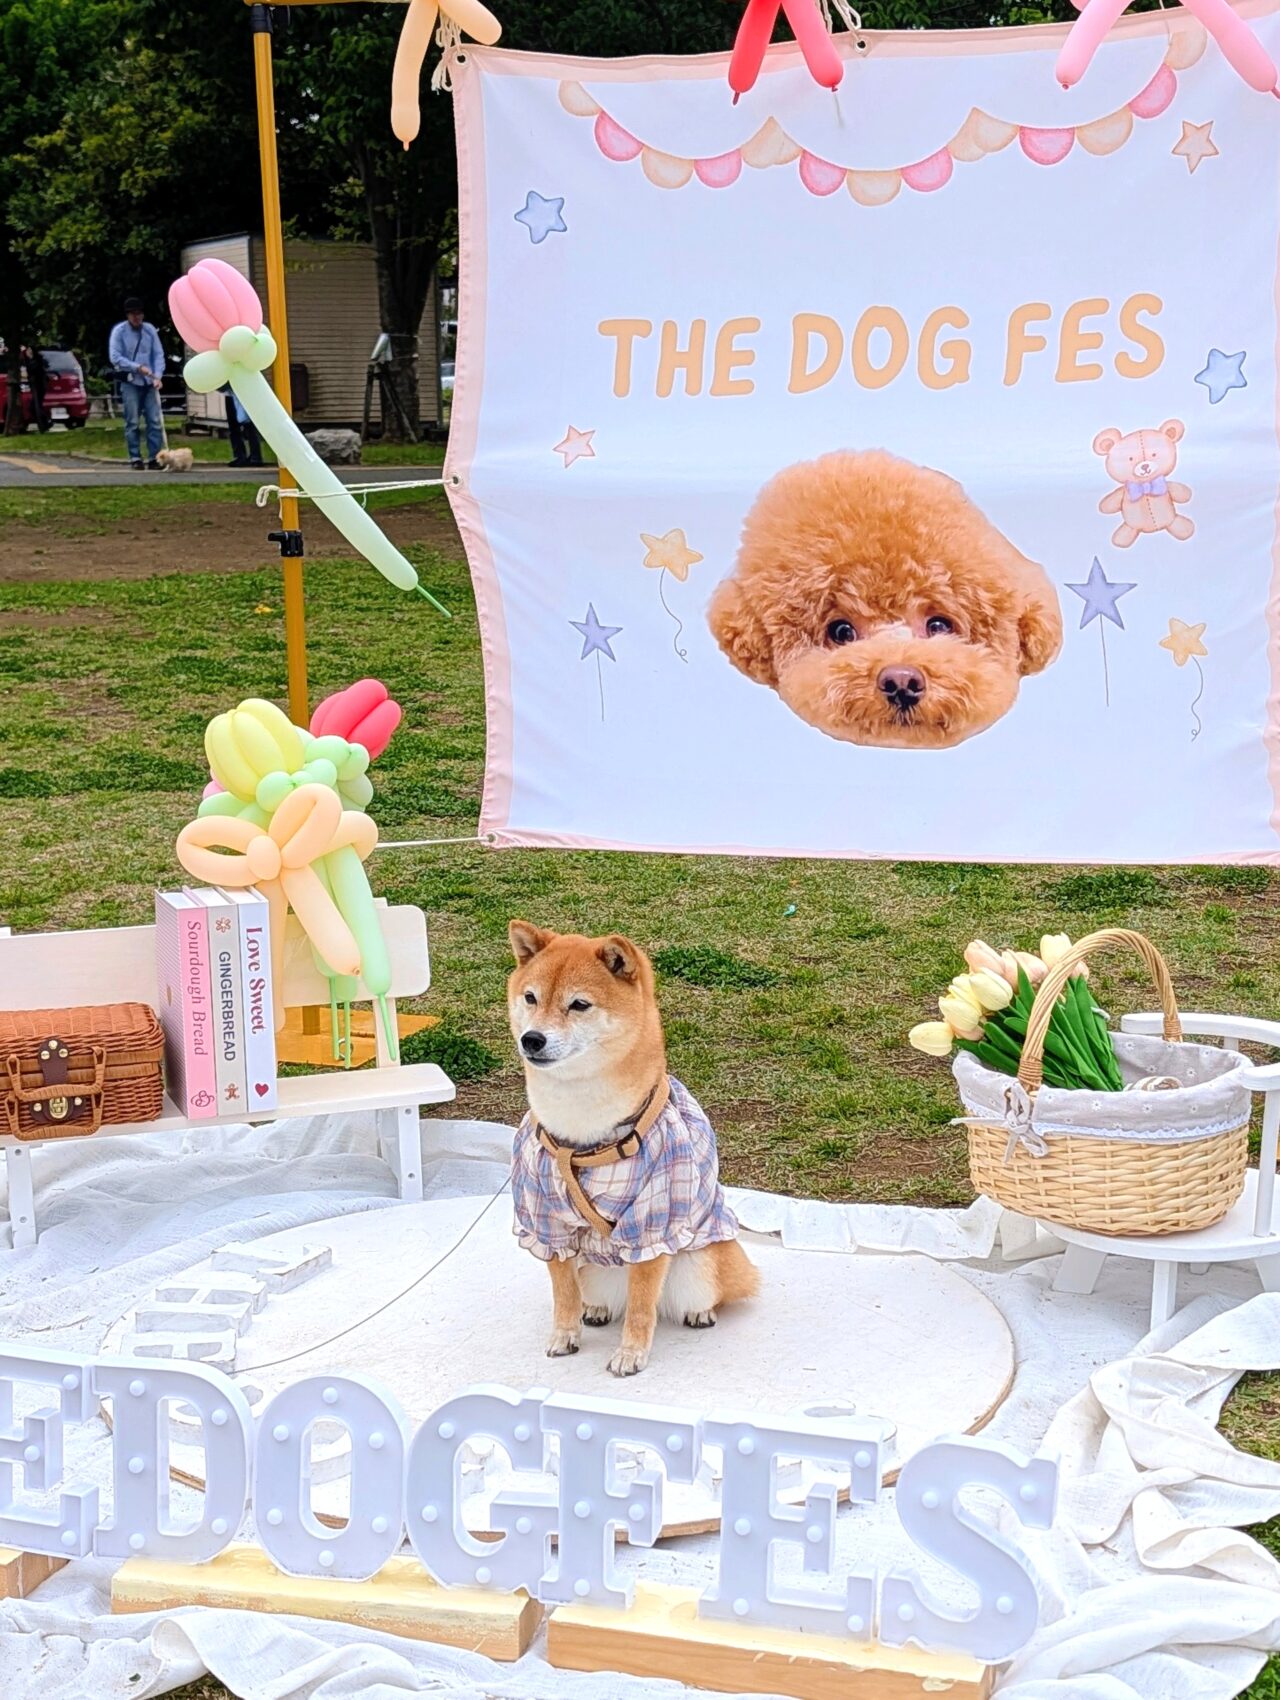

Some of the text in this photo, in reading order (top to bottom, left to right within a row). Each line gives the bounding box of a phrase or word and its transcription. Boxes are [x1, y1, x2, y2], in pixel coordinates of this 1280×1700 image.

[598, 293, 1165, 398] THE DOG FES
[187, 920, 208, 1056] Sourdough Bread
[218, 951, 236, 1062] GINGERBREAD
[246, 927, 267, 1034] Love Sweet
